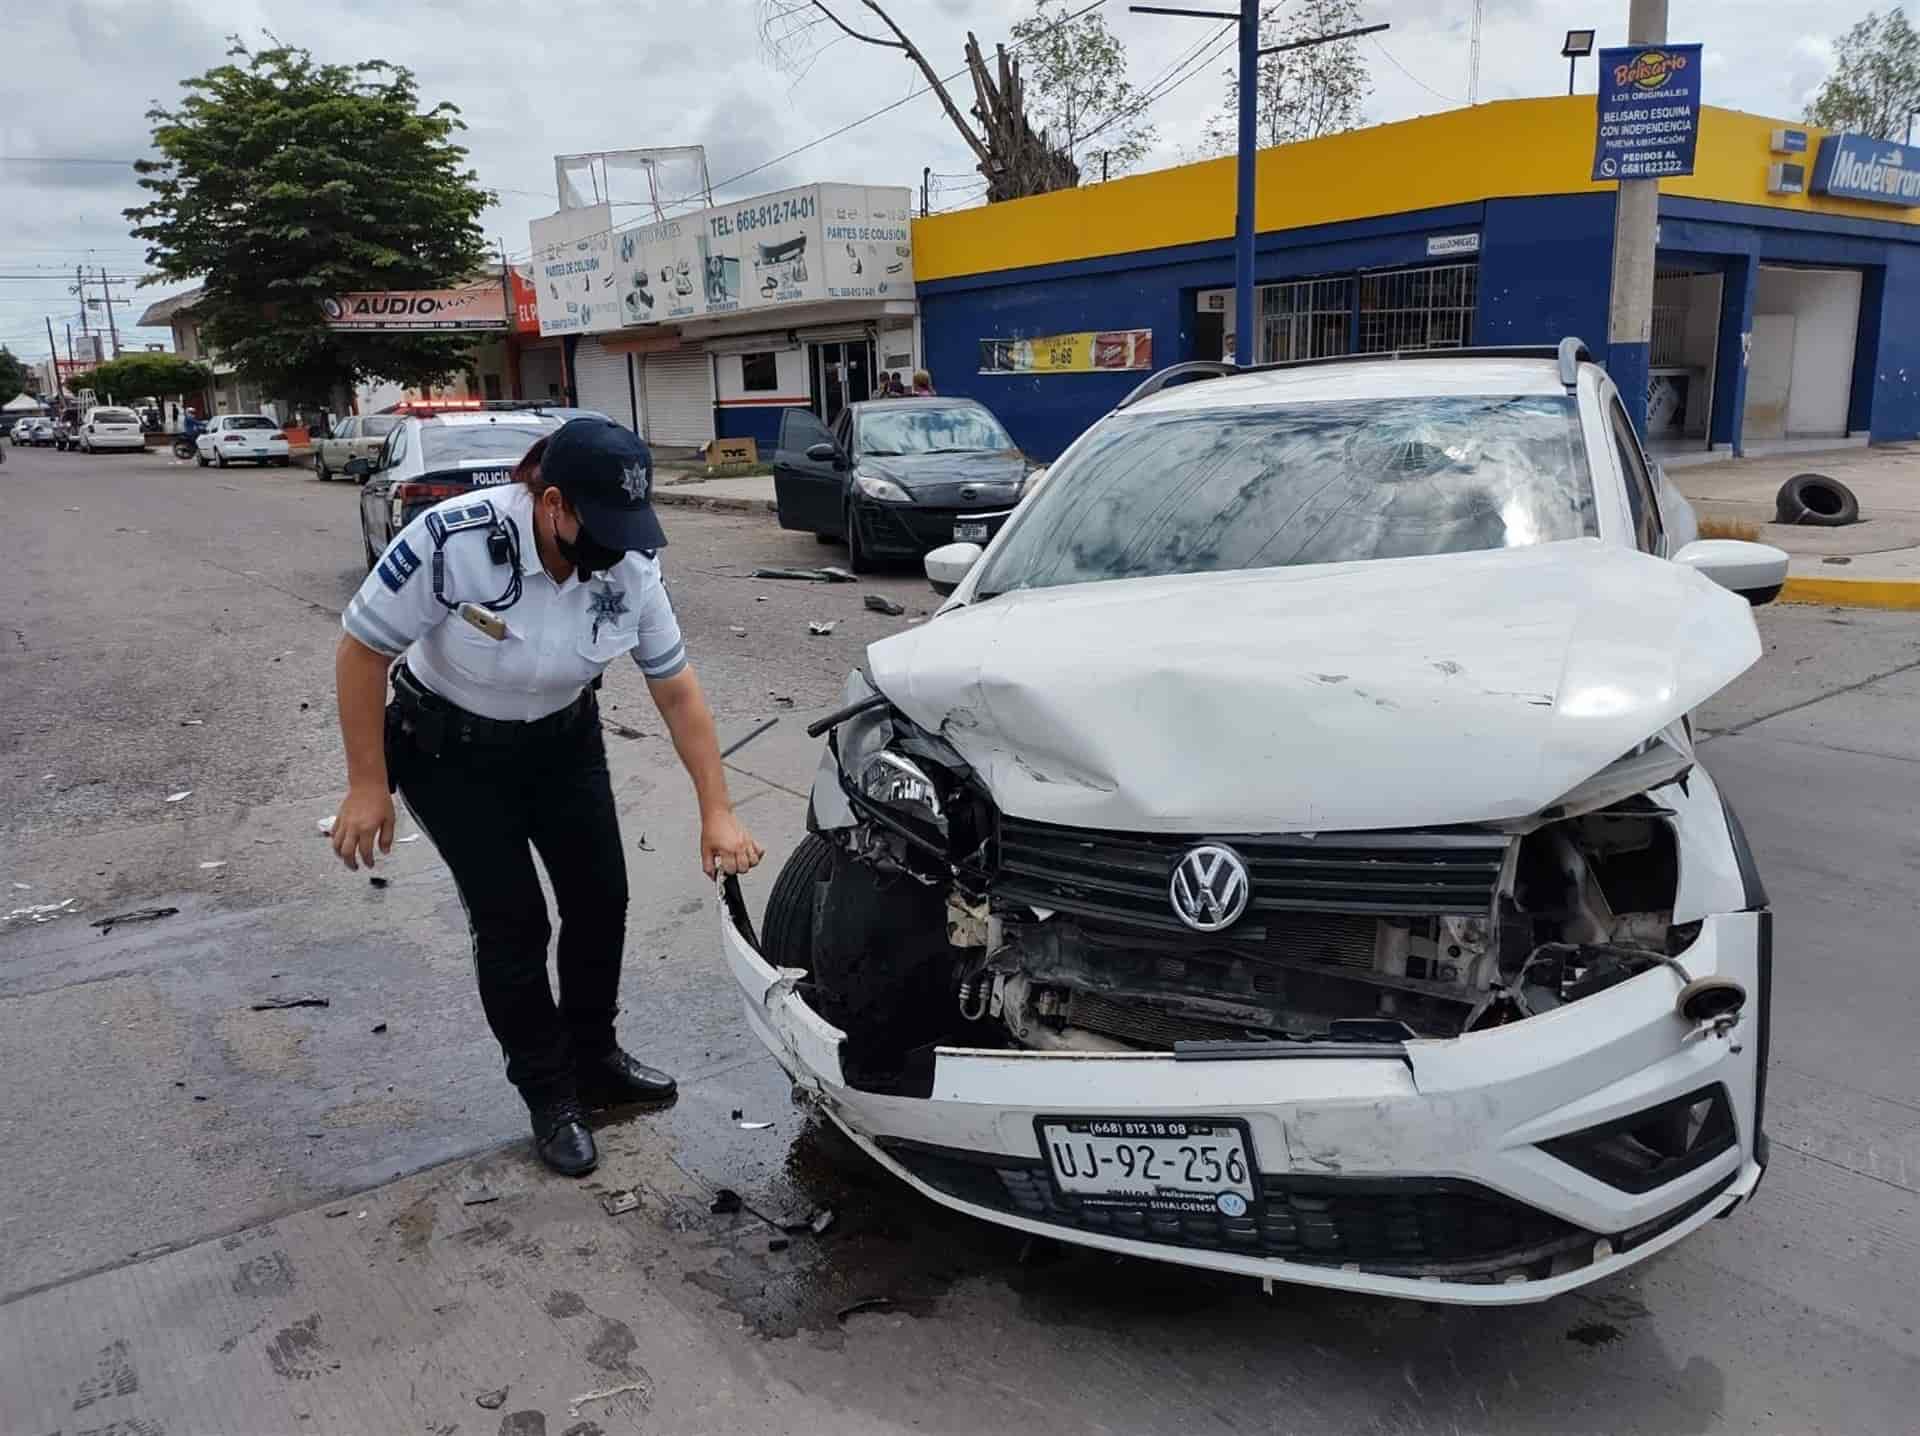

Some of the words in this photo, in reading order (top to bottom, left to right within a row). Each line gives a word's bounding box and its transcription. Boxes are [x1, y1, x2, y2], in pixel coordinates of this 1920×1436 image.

[1614, 54, 1688, 87] Belisario
[1611, 92, 1629, 102] LOS
[1632, 88, 1689, 101] ORIGINALES
[1603, 109, 1649, 123] BELISARIO
[1650, 105, 1691, 119] ESQUINA
[1600, 125, 1619, 137] CON
[1621, 120, 1692, 136] INDEPENDENCIA
[1605, 138, 1635, 148] NUEVA
[1623, 150, 1663, 162] PEDIDOS
[1665, 149, 1678, 160] AL
[710, 215, 734, 238] TEL:
[736, 195, 816, 233] 668-812-74-01
[827, 226, 857, 241] PARTES
[859, 226, 870, 240] DE
[545, 263, 565, 276] PARTES
[565, 261, 574, 274] DE
[353, 297, 436, 315] AUDIO
[472, 468, 511, 486] POLICÍA
[1089, 1121, 1123, 1136] (668)
[1125, 1122, 1149, 1135] 812
[1150, 1123, 1165, 1135] 18
[1168, 1123, 1187, 1135] 08
[1053, 1142, 1245, 1185] UJ-92-256
[1150, 1200, 1217, 1212] SINALOENSE
